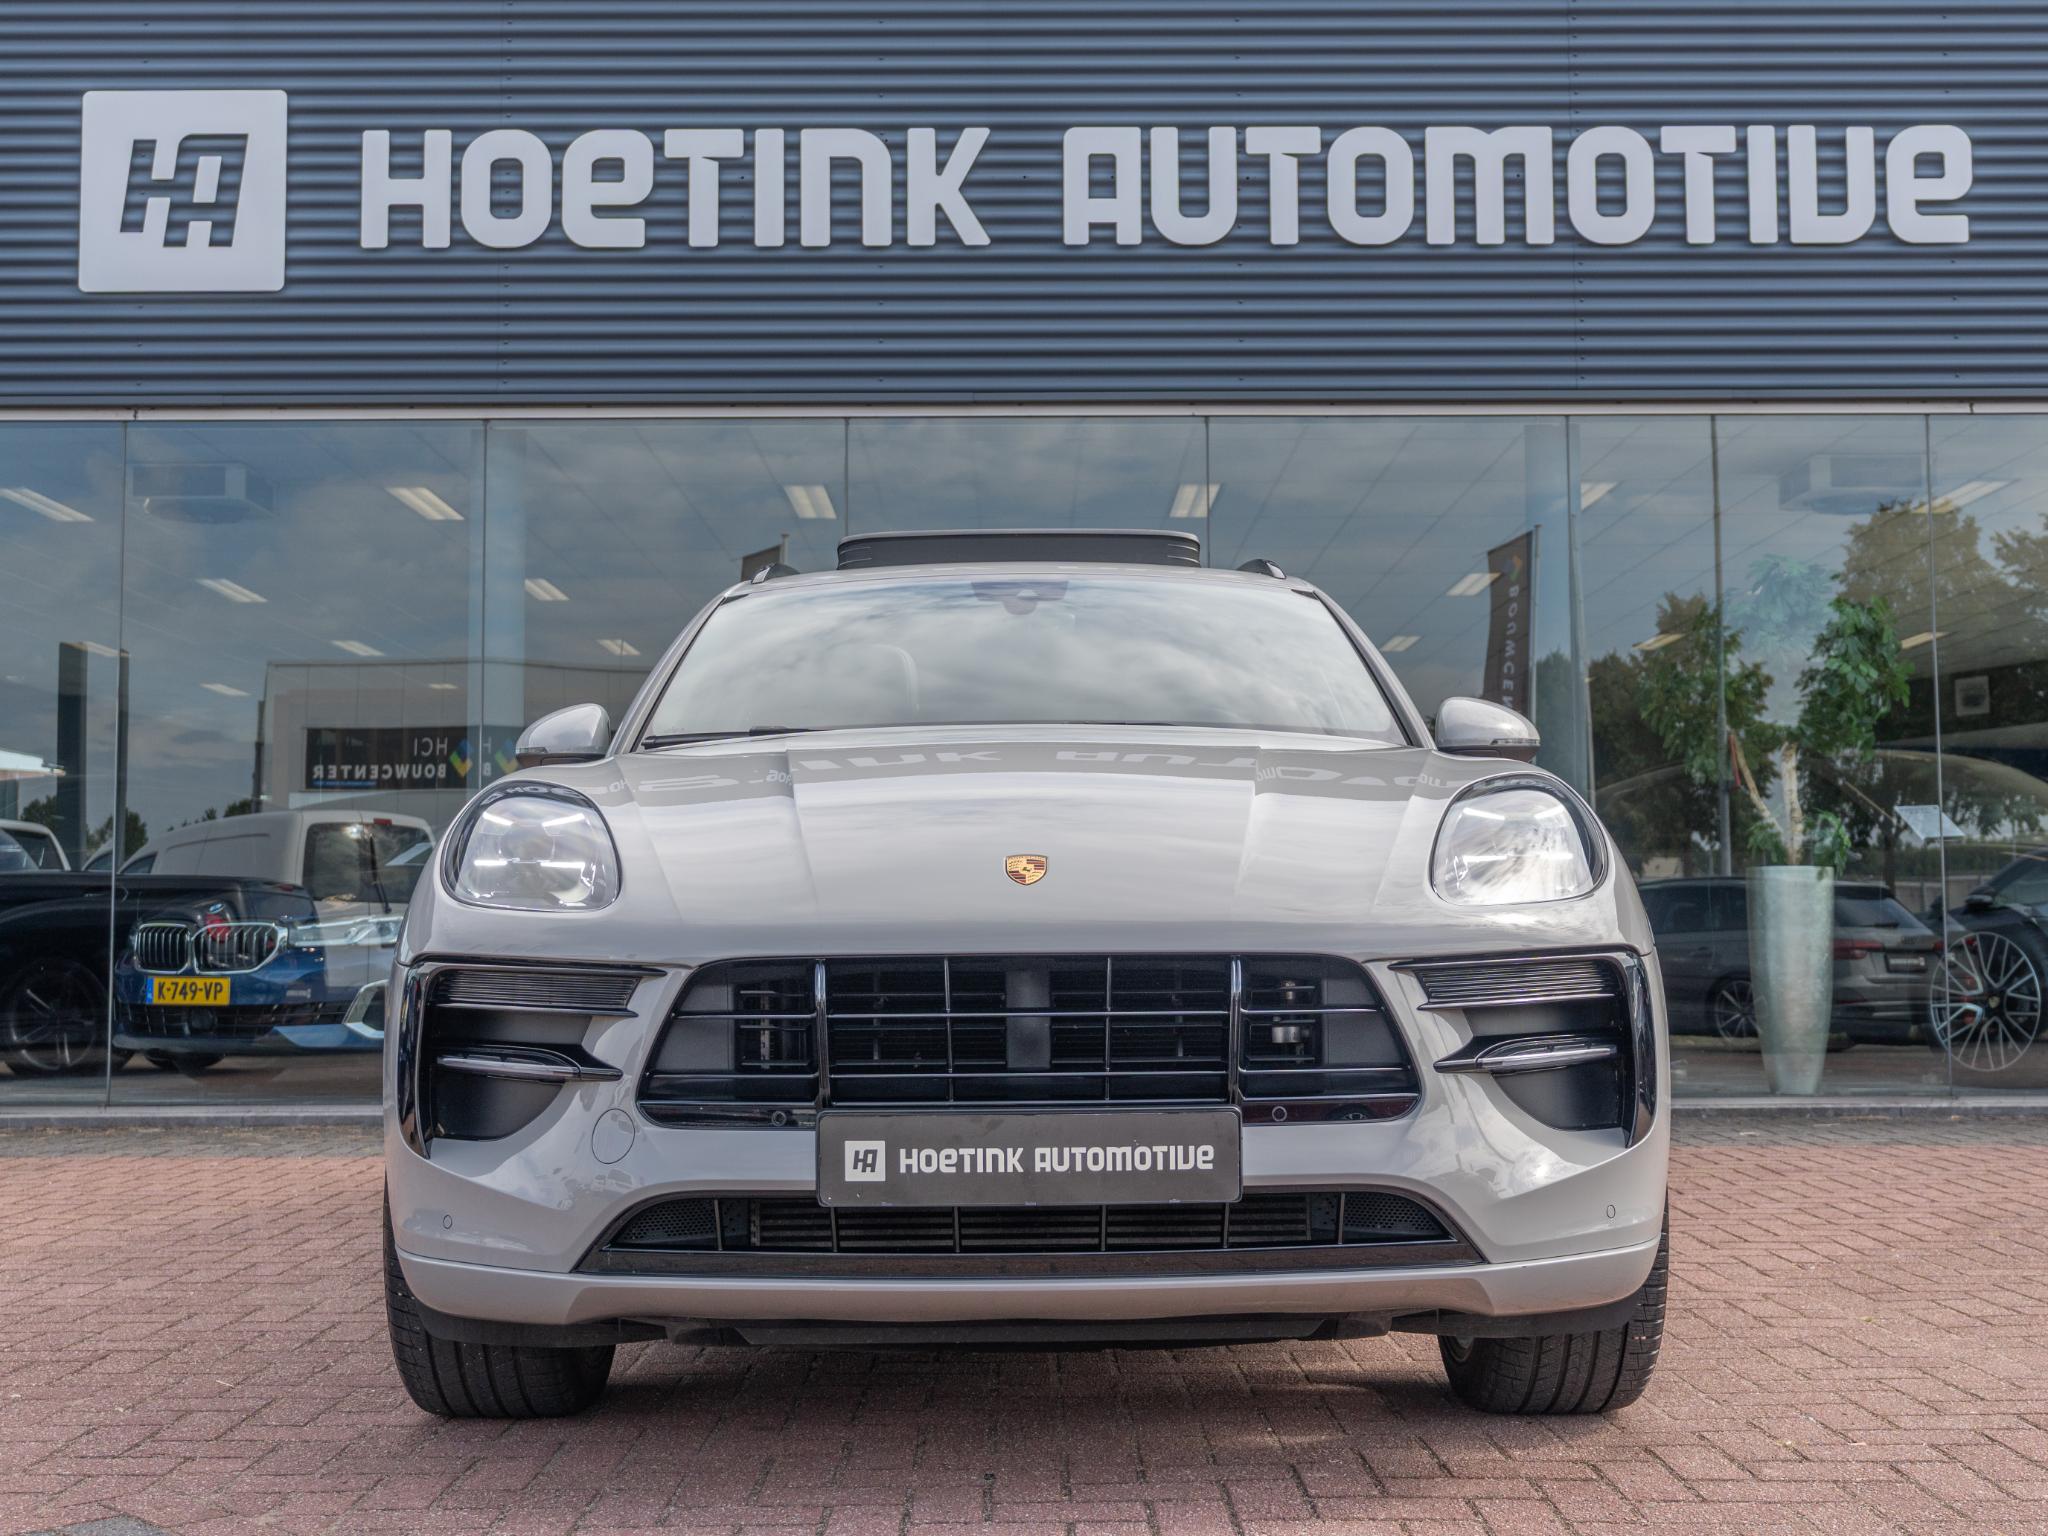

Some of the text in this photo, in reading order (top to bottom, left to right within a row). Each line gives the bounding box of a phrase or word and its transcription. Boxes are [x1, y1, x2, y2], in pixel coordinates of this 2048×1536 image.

[360, 124, 1974, 249] HOETINK AUTOMOTIVE
[157, 982, 223, 1000] K-749-VP
[899, 1144, 1215, 1174] HOETINK AUTOMOTIVE
